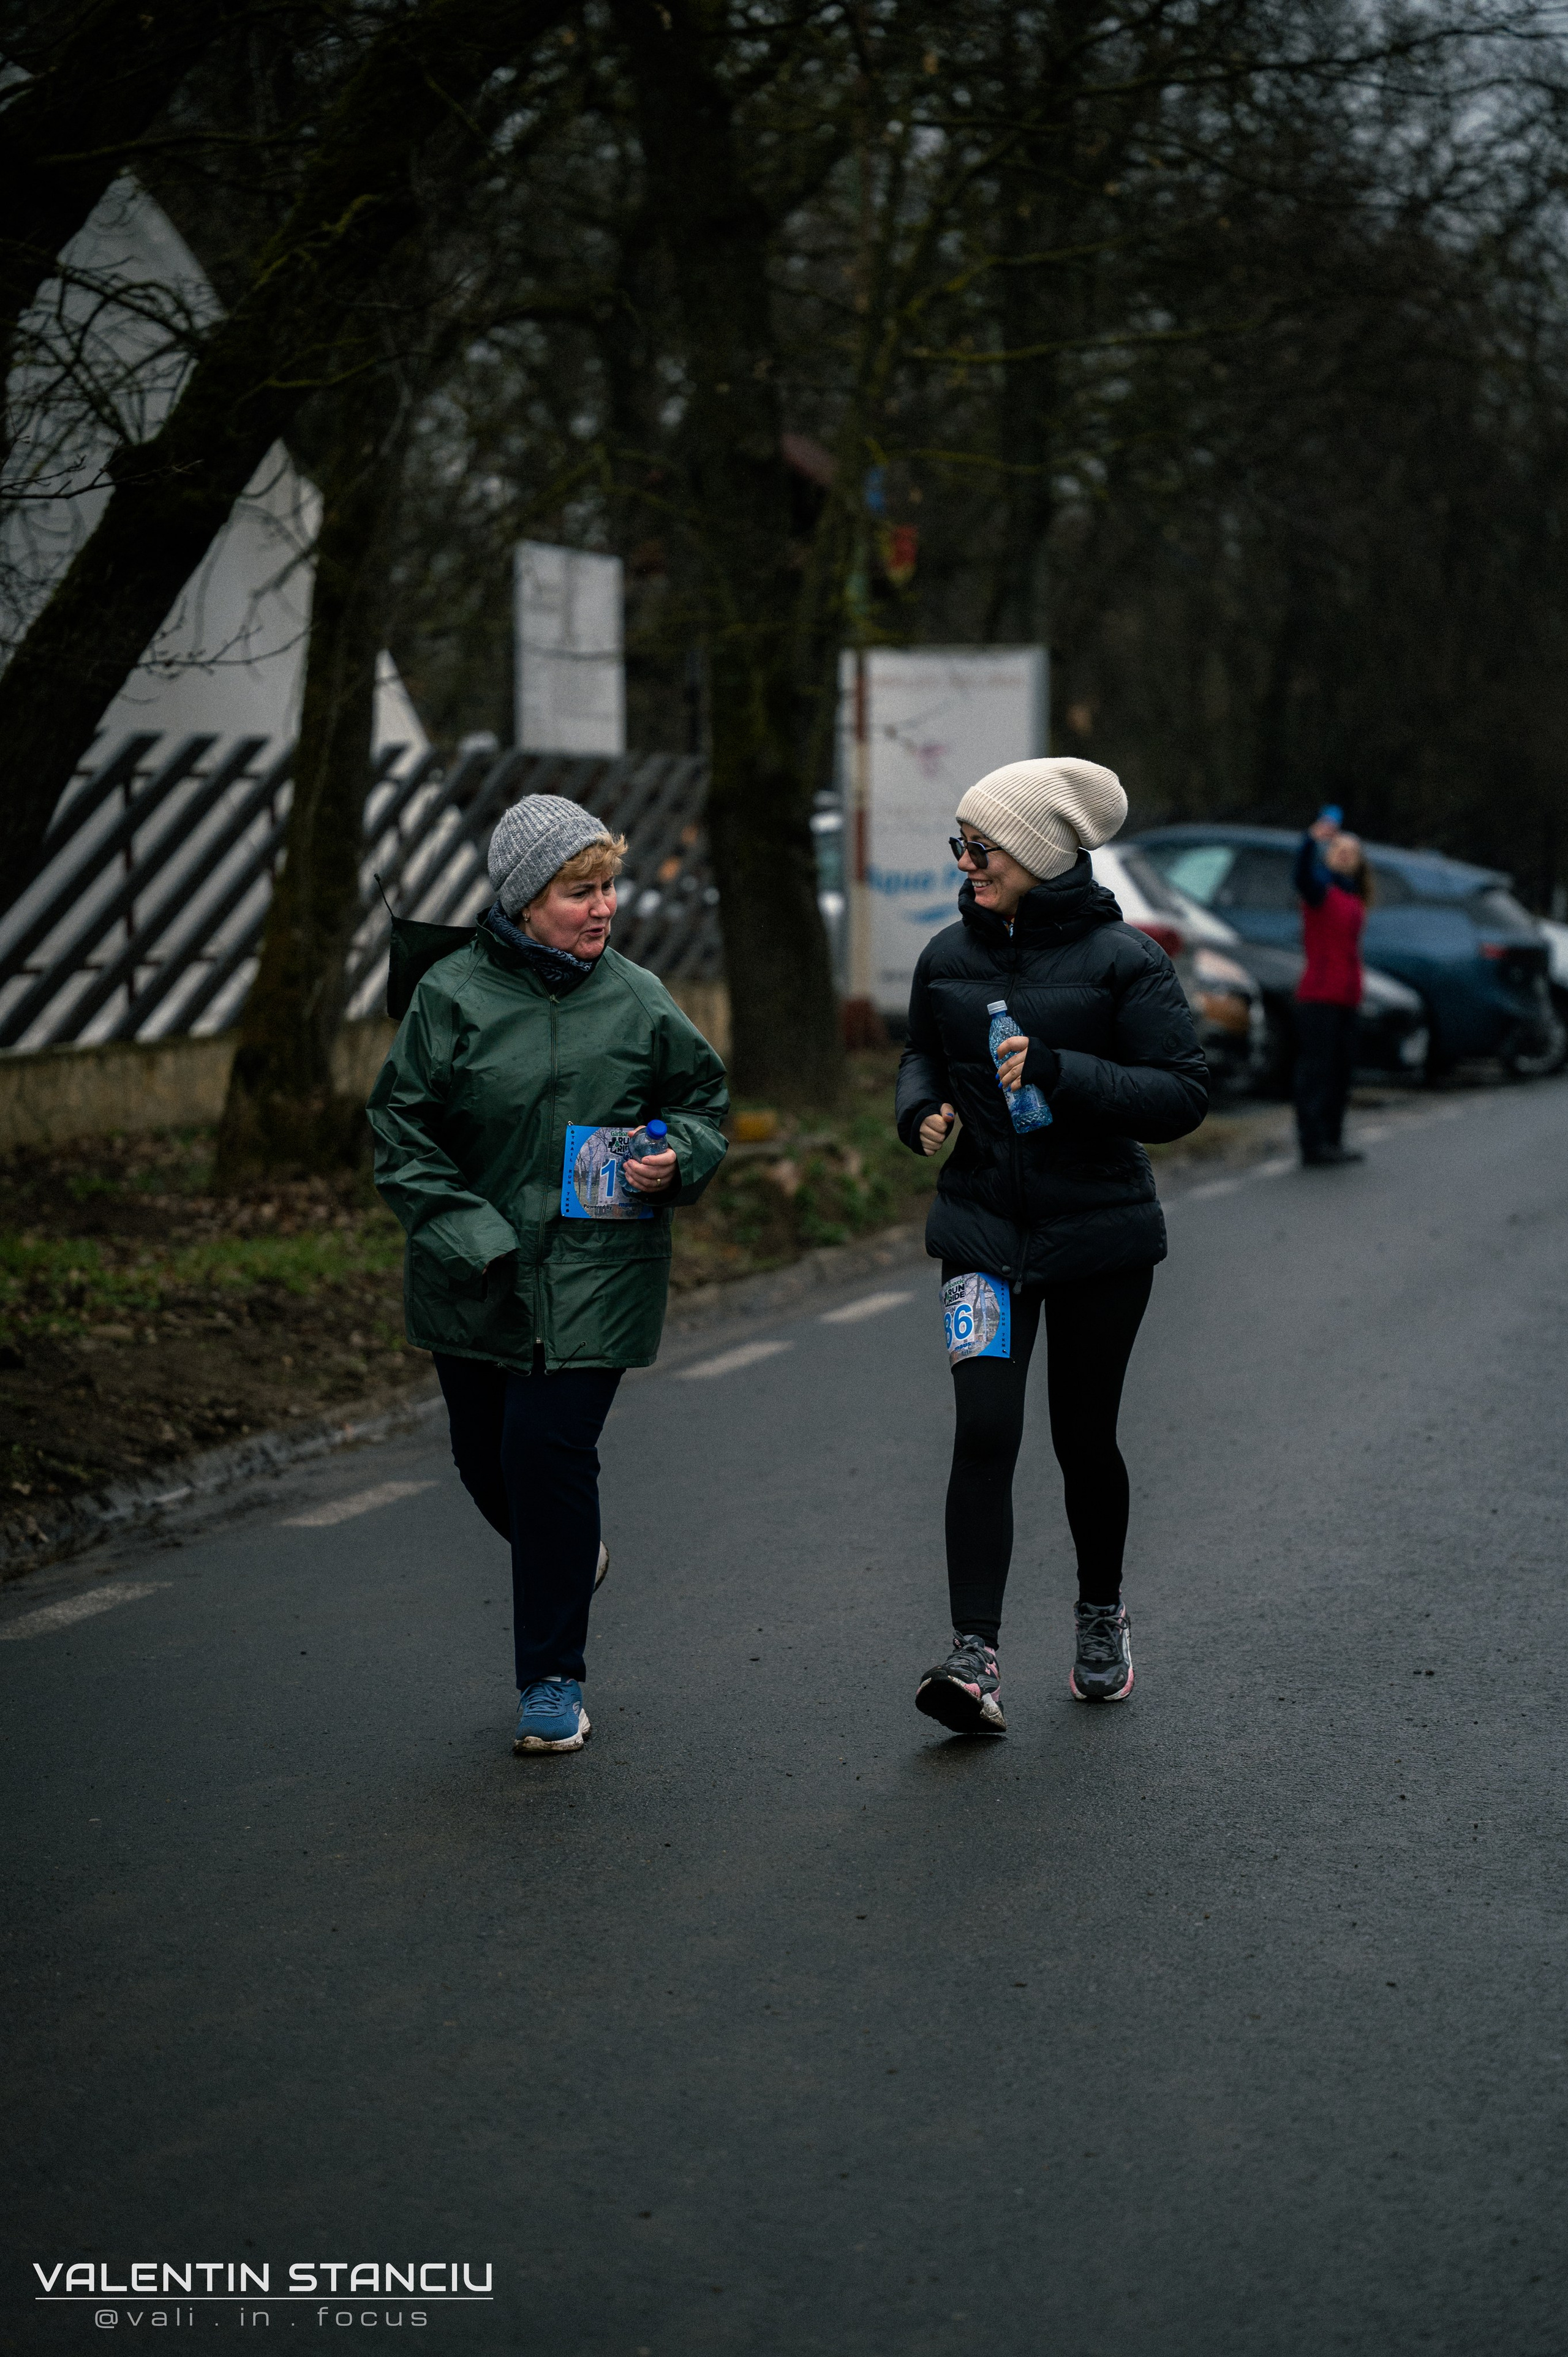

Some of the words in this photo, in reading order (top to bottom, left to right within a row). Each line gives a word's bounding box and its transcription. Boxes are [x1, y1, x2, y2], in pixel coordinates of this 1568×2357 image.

[948, 1284, 965, 1295] RUN
[948, 1291, 965, 1303] RIDE
[944, 1304, 973, 1349] 86
